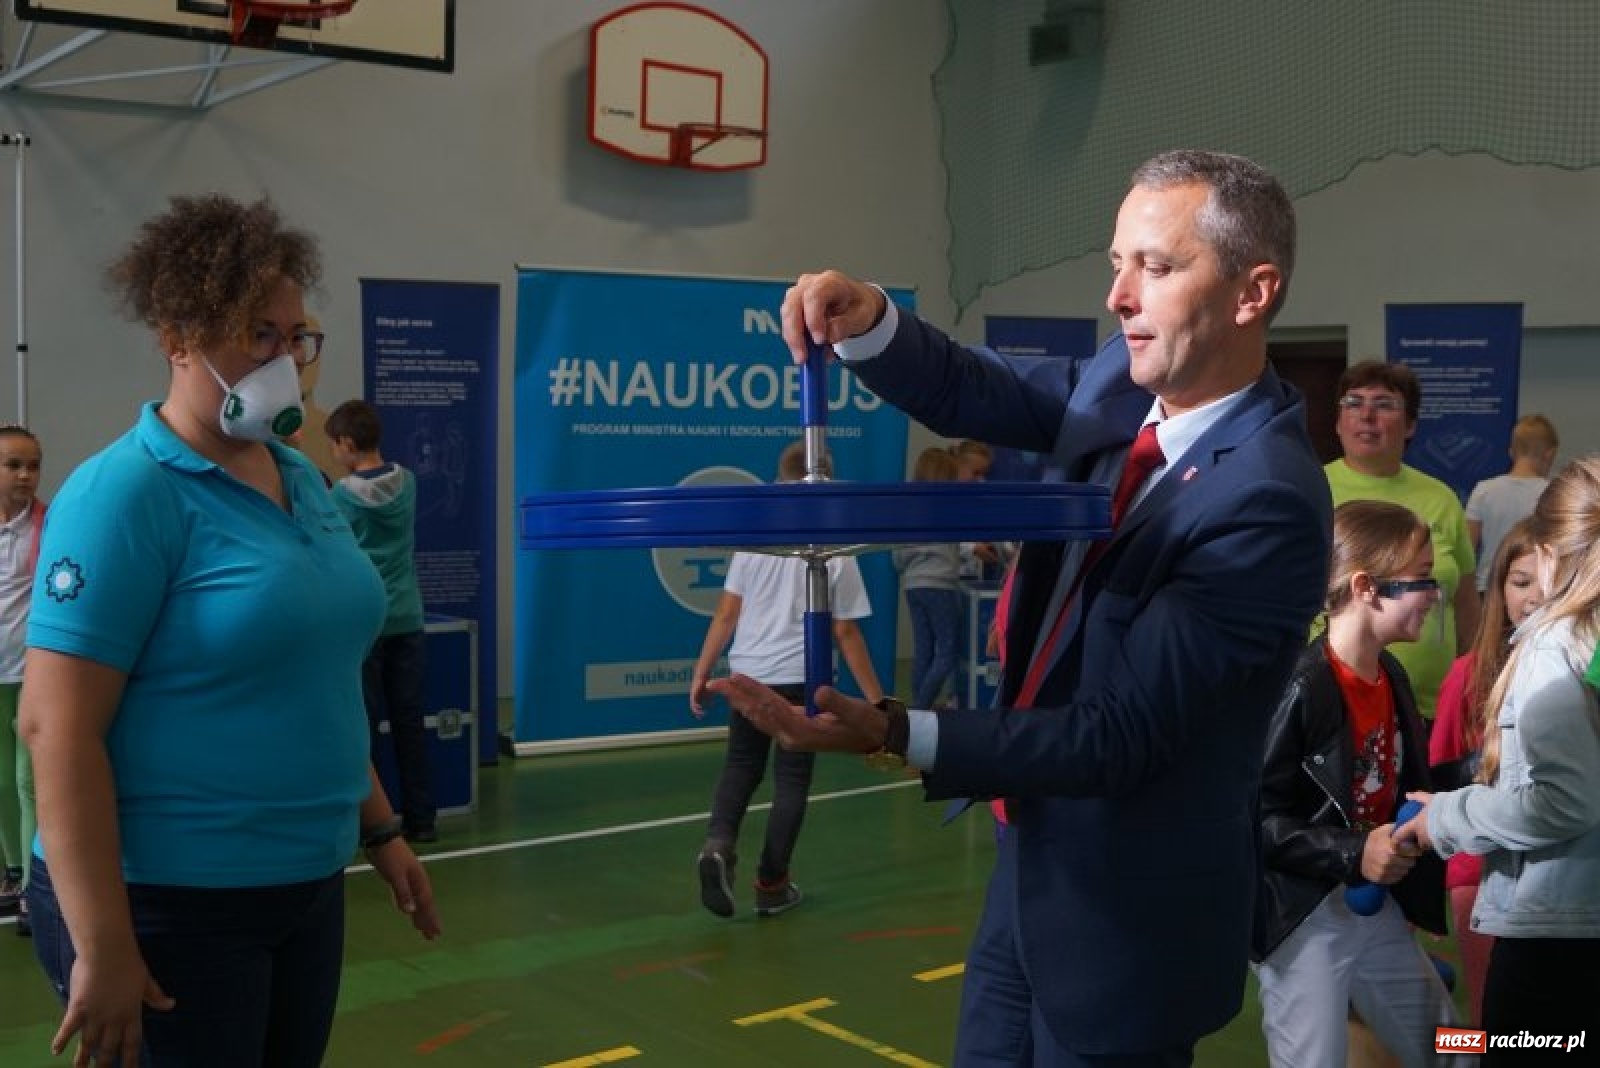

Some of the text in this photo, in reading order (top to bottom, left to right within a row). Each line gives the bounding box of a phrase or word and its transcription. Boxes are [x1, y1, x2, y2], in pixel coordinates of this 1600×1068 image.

[572, 423, 630, 434] PROGRAM
[631, 424, 685, 435] MINISTRA
[687, 424, 721, 435] NAUKI
